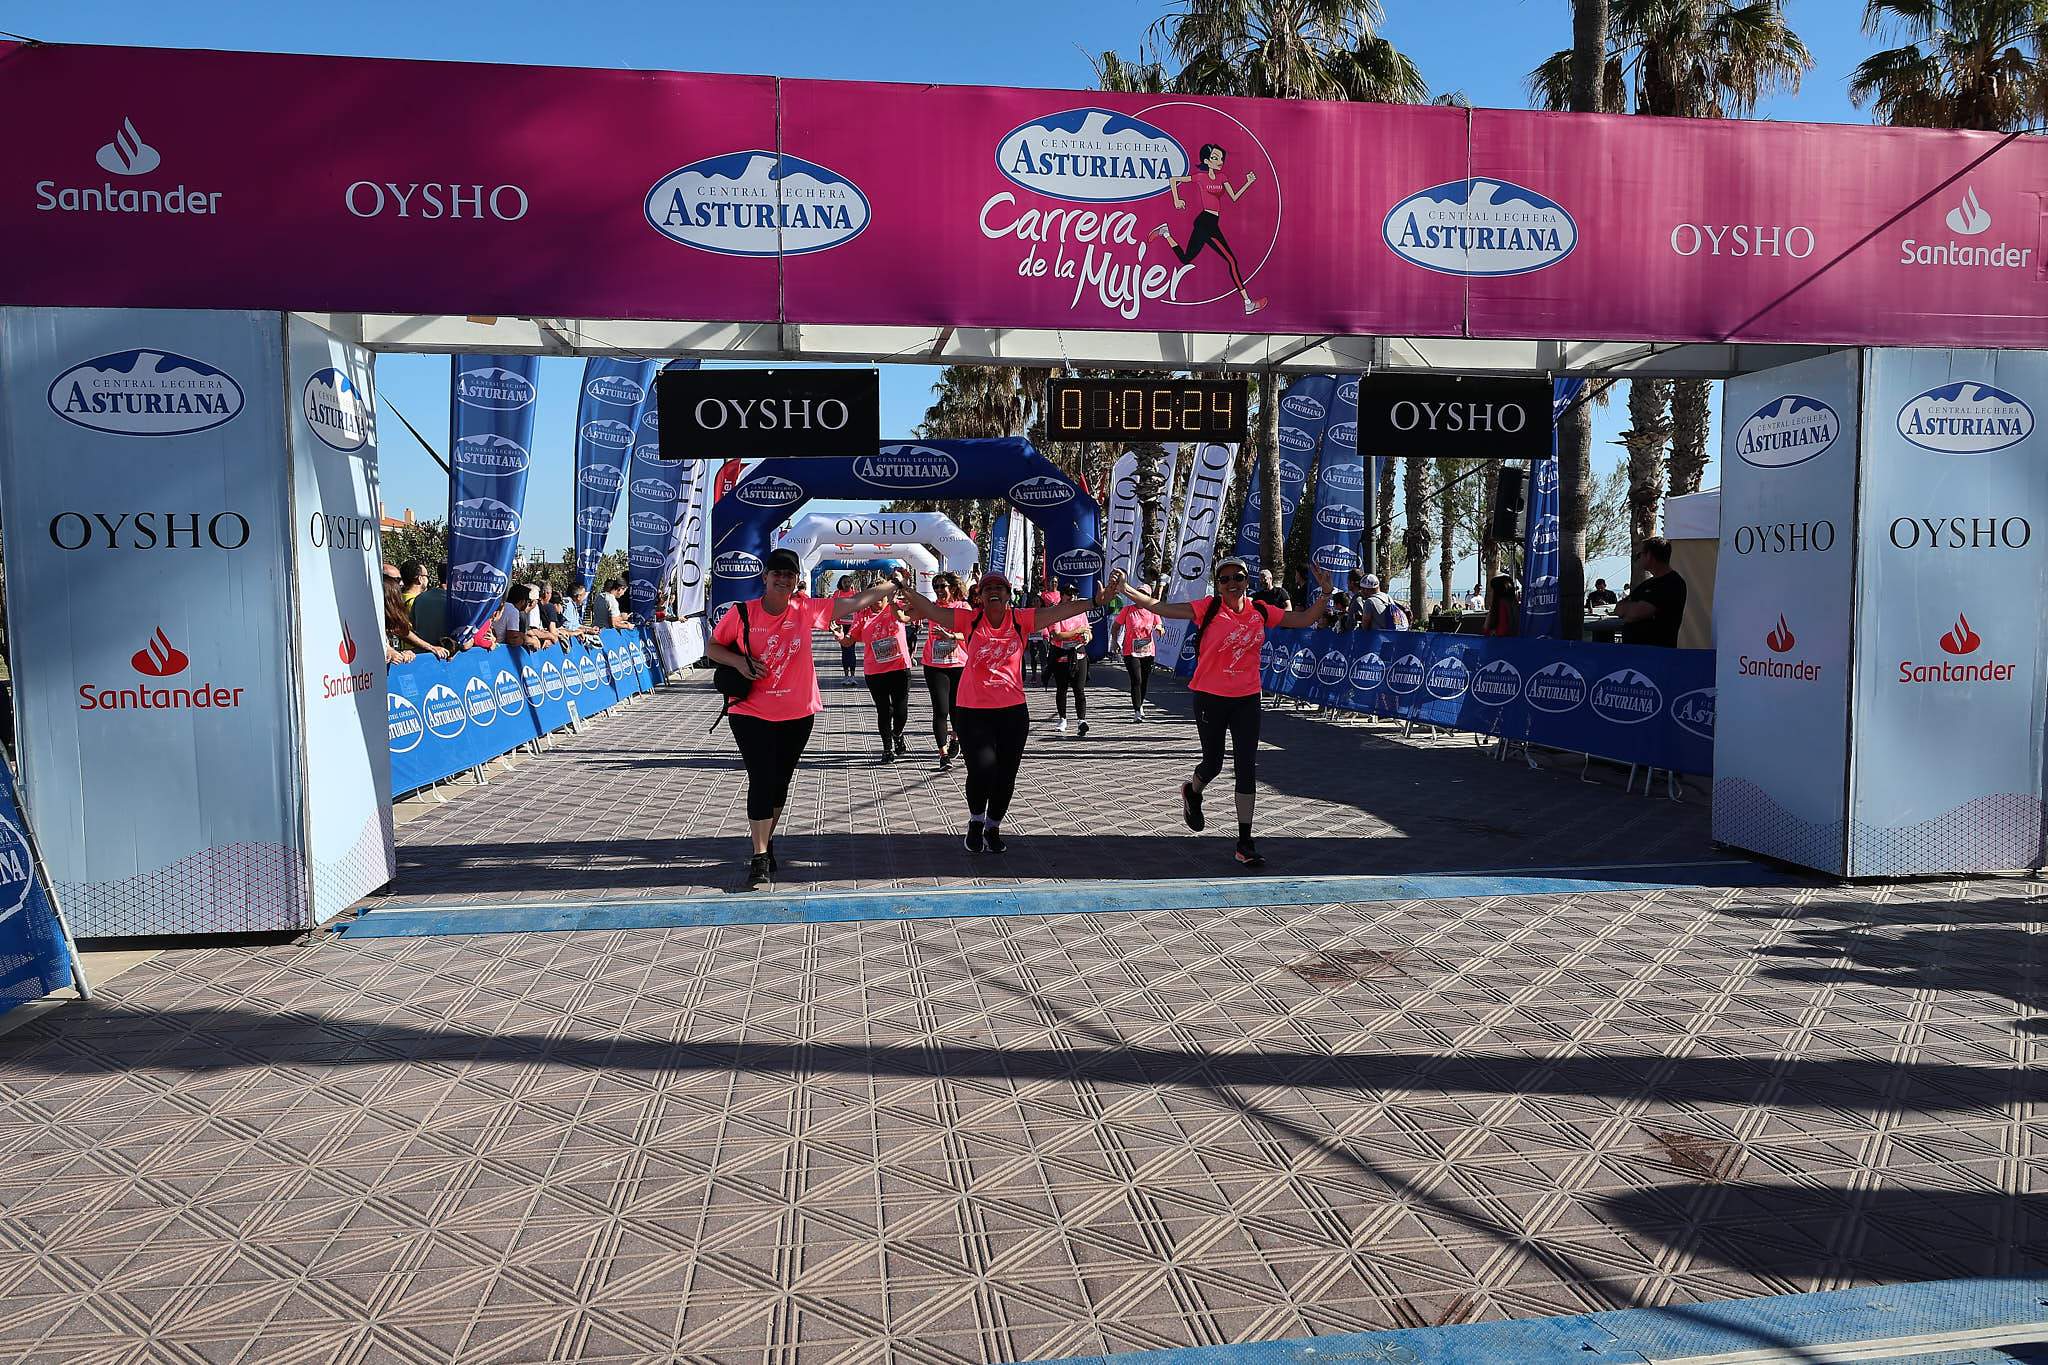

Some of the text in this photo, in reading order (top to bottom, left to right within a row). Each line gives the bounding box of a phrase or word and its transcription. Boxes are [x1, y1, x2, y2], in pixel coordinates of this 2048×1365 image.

[1041, 139, 1168, 153] CENTRAL LECHERA
[1011, 139, 1172, 180] ASTURIANA
[35, 180, 223, 214] Santander
[345, 180, 529, 221] OYSHO
[697, 186, 767, 197] CENTRAL
[663, 187, 853, 229] ASTURIANA
[979, 192, 1137, 245] Carrera
[1428, 211, 1557, 223] CENTRAL LECHERA
[1398, 212, 1562, 251] ASTURIANA
[1671, 223, 1816, 259] OYSHO
[1901, 238, 2032, 269] Santander
[1018, 241, 1196, 320] de la Mujer
[93, 379, 223, 389] CENTRAL LECHERA
[458, 379, 528, 401] ASTURIANA
[592, 383, 640, 401] ASTURIANA
[64, 381, 230, 414] ASTURIANA
[1285, 399, 1321, 417] ASTURIANA
[309, 389, 366, 437] ASTURIANA
[695, 398, 849, 431] OYSHO
[1061, 389, 1232, 431] 01:06:24
[1390, 400, 1526, 433] OYSHO
[1906, 407, 2023, 436] ASTURIANA
[1928, 406, 2020, 415] CENTRAL LECHERA
[1742, 423, 1831, 455] ASTURIANA
[455, 446, 522, 468] ASTURIANA
[861, 457, 950, 478] ASTURIANA
[1326, 471, 1363, 486] ASTURIA
[633, 484, 673, 499] ASTURIANA
[741, 485, 798, 499] ASTURIANA
[1014, 488, 1071, 500] ASTURIANA
[1177, 443, 1230, 580] OYSHO
[49, 511, 250, 551] OYSHO
[311, 512, 373, 551] OYSHO
[835, 519, 917, 536] OYSHO
[1735, 520, 1835, 555] OYSHO
[1889, 516, 2031, 550] OYSHO
[631, 554, 663, 565] STURIANA
[715, 563, 760, 573] ASTURIANA
[1316, 554, 1357, 568] ASTURIANA
[1351, 668, 1382, 682] ASTURIANA
[1389, 671, 1421, 685] ASTURIANA
[1739, 655, 1821, 681] Santander
[1899, 660, 2016, 683] Santander
[323, 668, 374, 699] Santander
[1428, 672, 1465, 690] ASTURIANA
[1474, 675, 1517, 696] ASTURIANA
[1528, 680, 1580, 702] ASTURIANA
[80, 683, 243, 710] Santander
[1594, 686, 1653, 713] ASTURIANA
[428, 706, 465, 728] ASTURIANA
